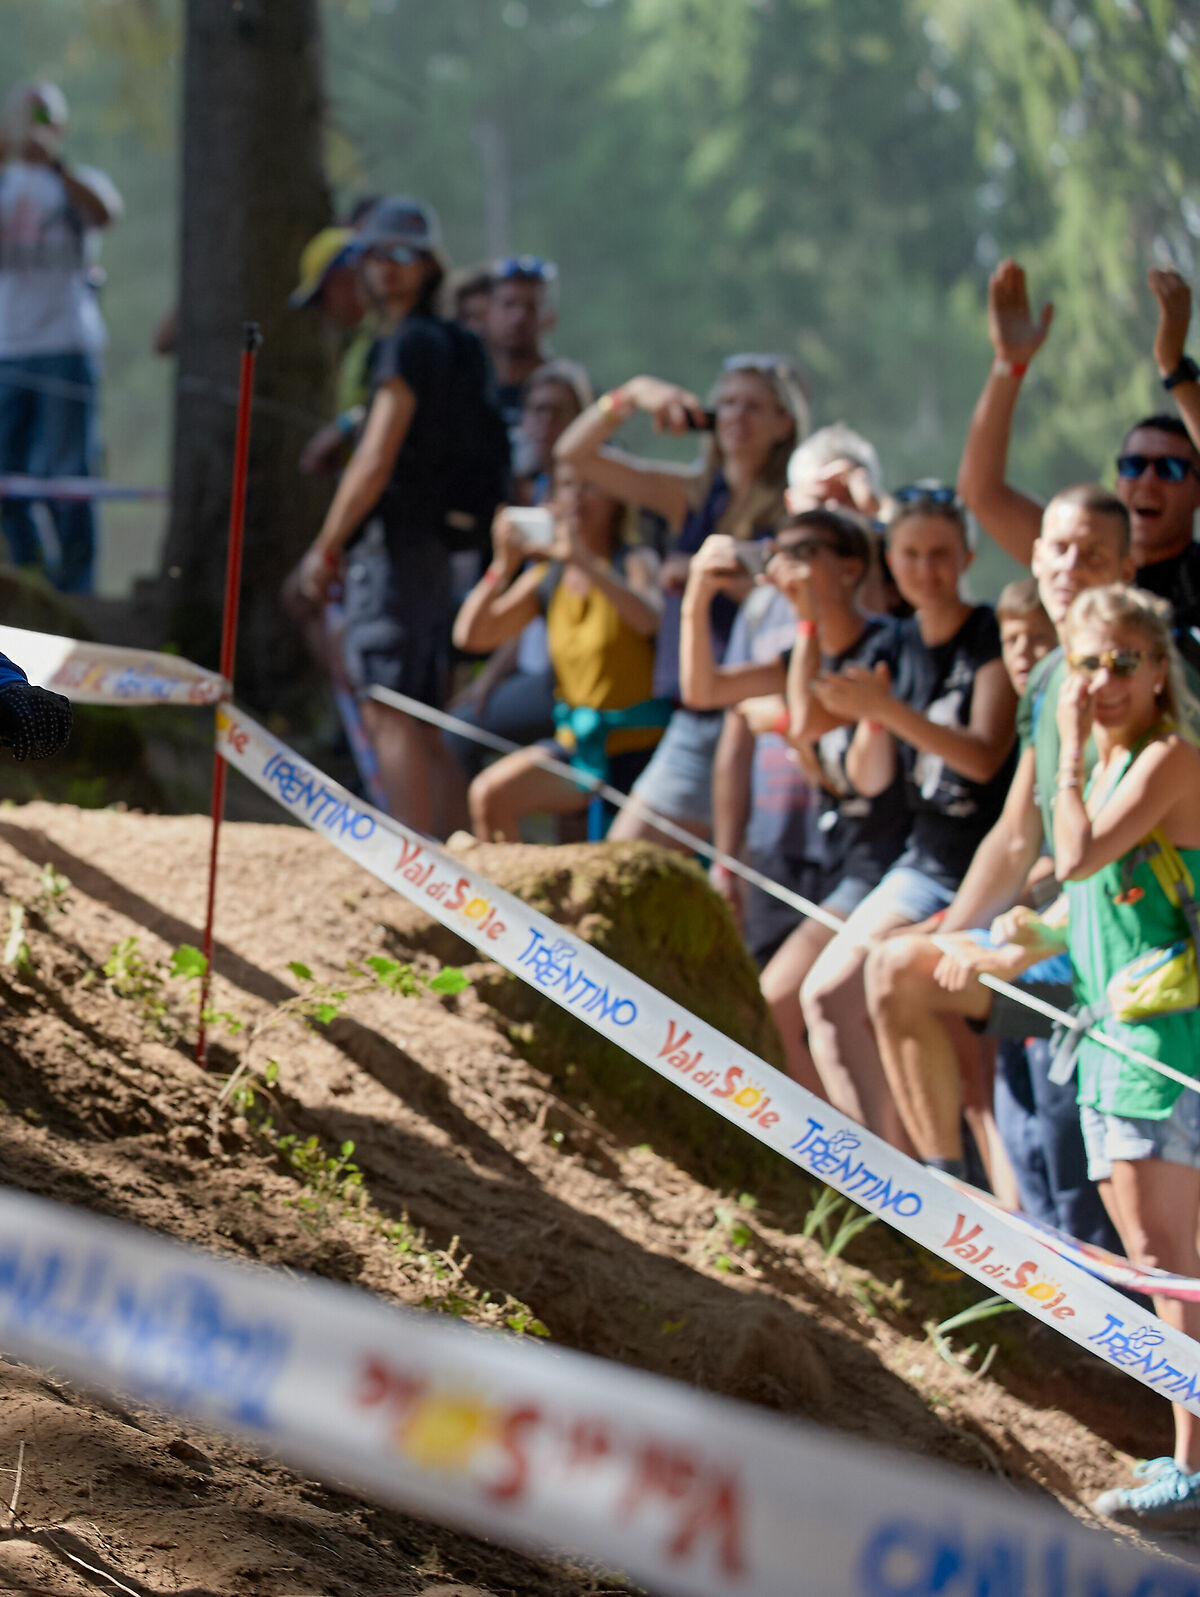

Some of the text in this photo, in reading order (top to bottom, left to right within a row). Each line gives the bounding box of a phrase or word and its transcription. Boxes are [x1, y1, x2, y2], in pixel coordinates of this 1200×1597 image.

[393, 836, 434, 887] Val
[426, 881, 452, 901] di
[443, 877, 507, 941] Sole
[517, 926, 638, 1027] TRENTINO
[656, 1019, 703, 1074] Val
[692, 1069, 721, 1088] di
[710, 1065, 780, 1129] Sole
[791, 1118, 924, 1218] TRENTINO
[943, 1213, 994, 1266] Val
[980, 1263, 1009, 1280] di
[1003, 1260, 1077, 1321] Sole
[1088, 1313, 1200, 1403] TRENTIN
